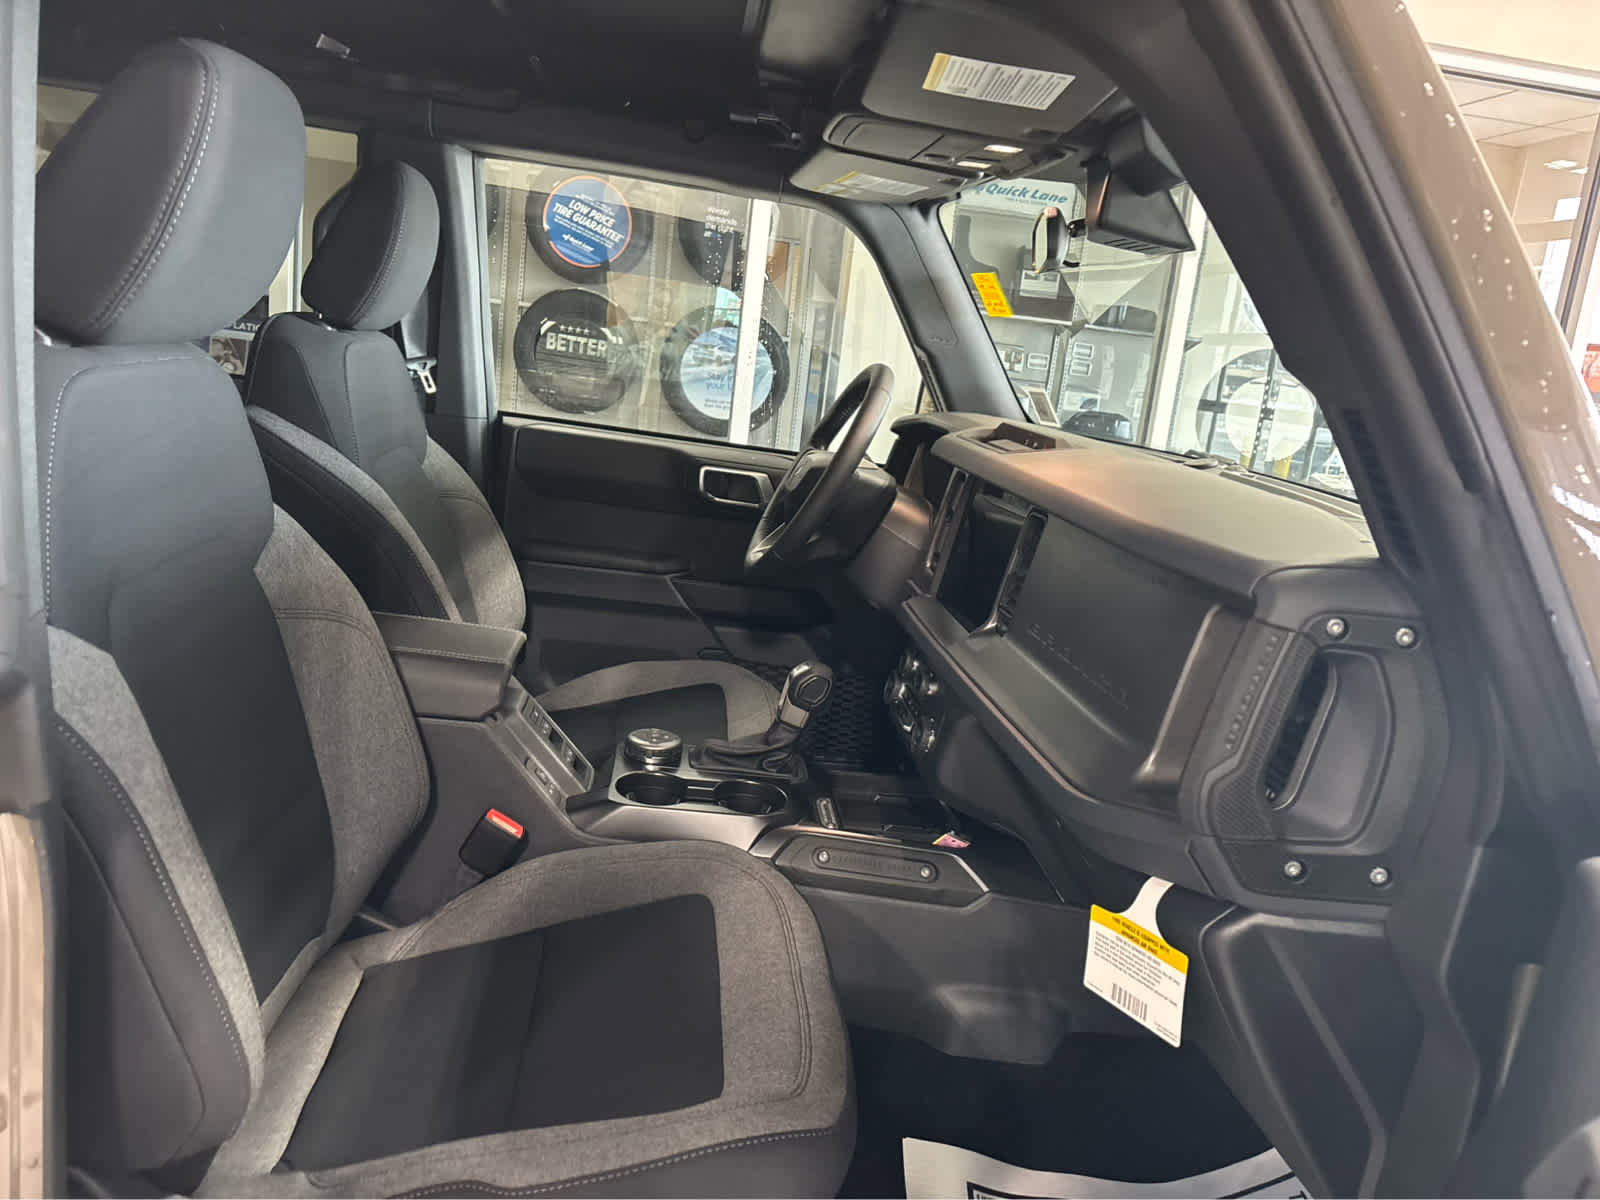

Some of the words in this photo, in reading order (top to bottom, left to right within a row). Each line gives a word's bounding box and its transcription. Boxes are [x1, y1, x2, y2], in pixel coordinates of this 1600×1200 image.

[986, 183, 1030, 200] Quick
[1030, 189, 1068, 204] Lane
[552, 202, 575, 219] TIRE
[572, 212, 622, 243] GUARANTEE
[568, 199, 591, 215] LOW
[588, 209, 616, 228] PRICE
[545, 331, 608, 358] BETTER
